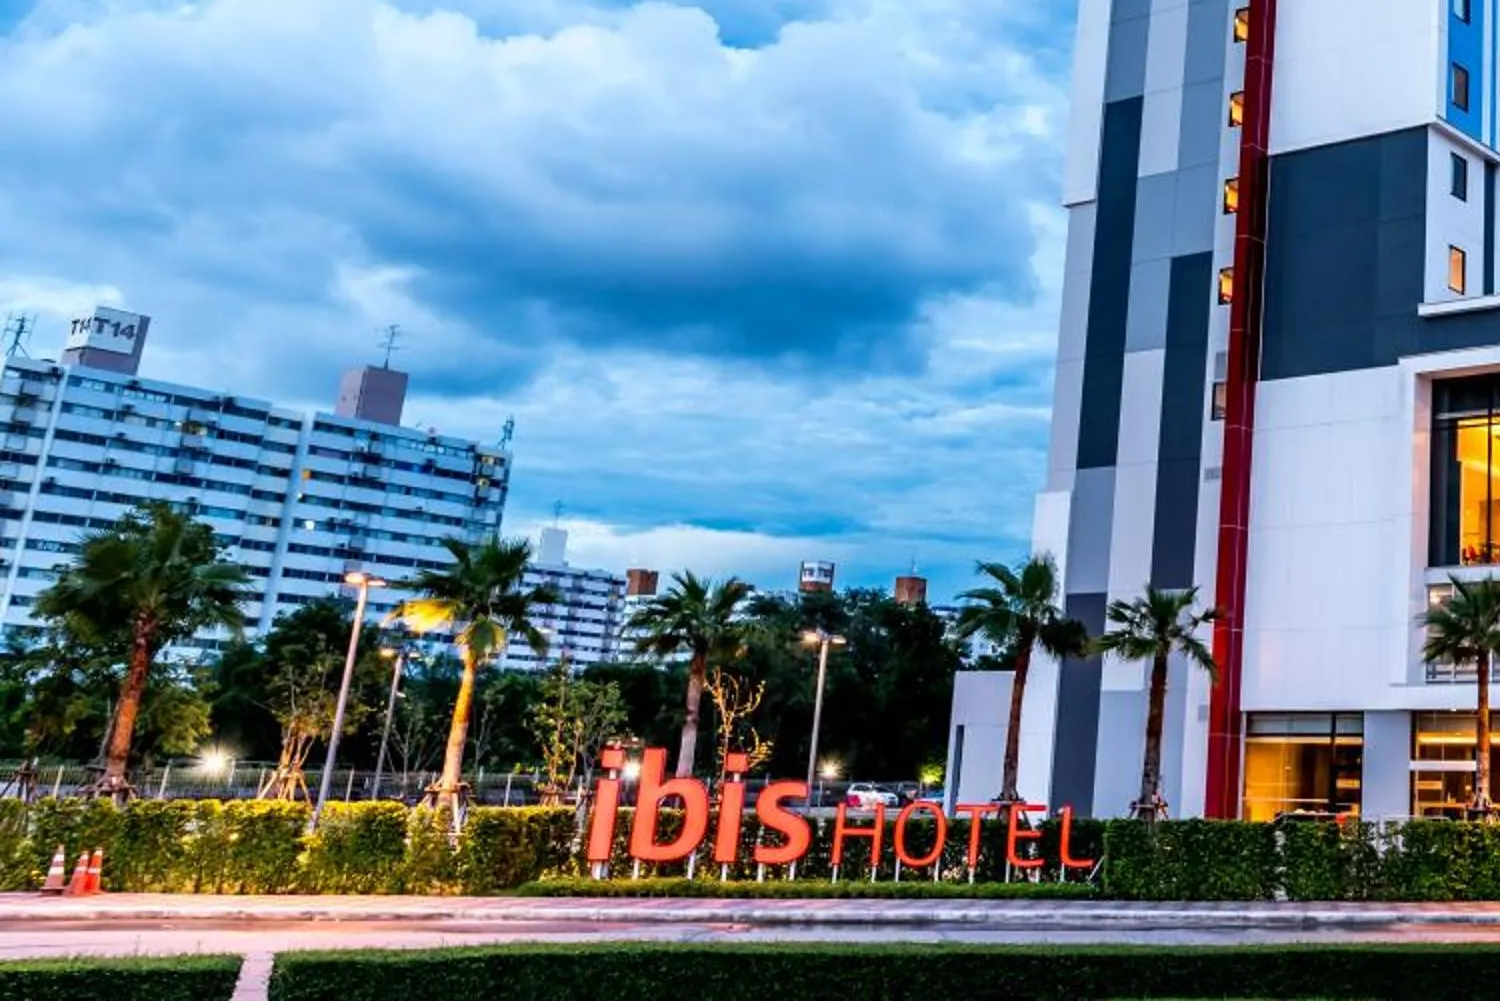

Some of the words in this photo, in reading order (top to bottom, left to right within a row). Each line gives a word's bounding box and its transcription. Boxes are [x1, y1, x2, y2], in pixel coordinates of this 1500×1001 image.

[93, 316, 136, 340] T14
[587, 747, 812, 864] ibis
[831, 801, 1094, 867] HOTEL
